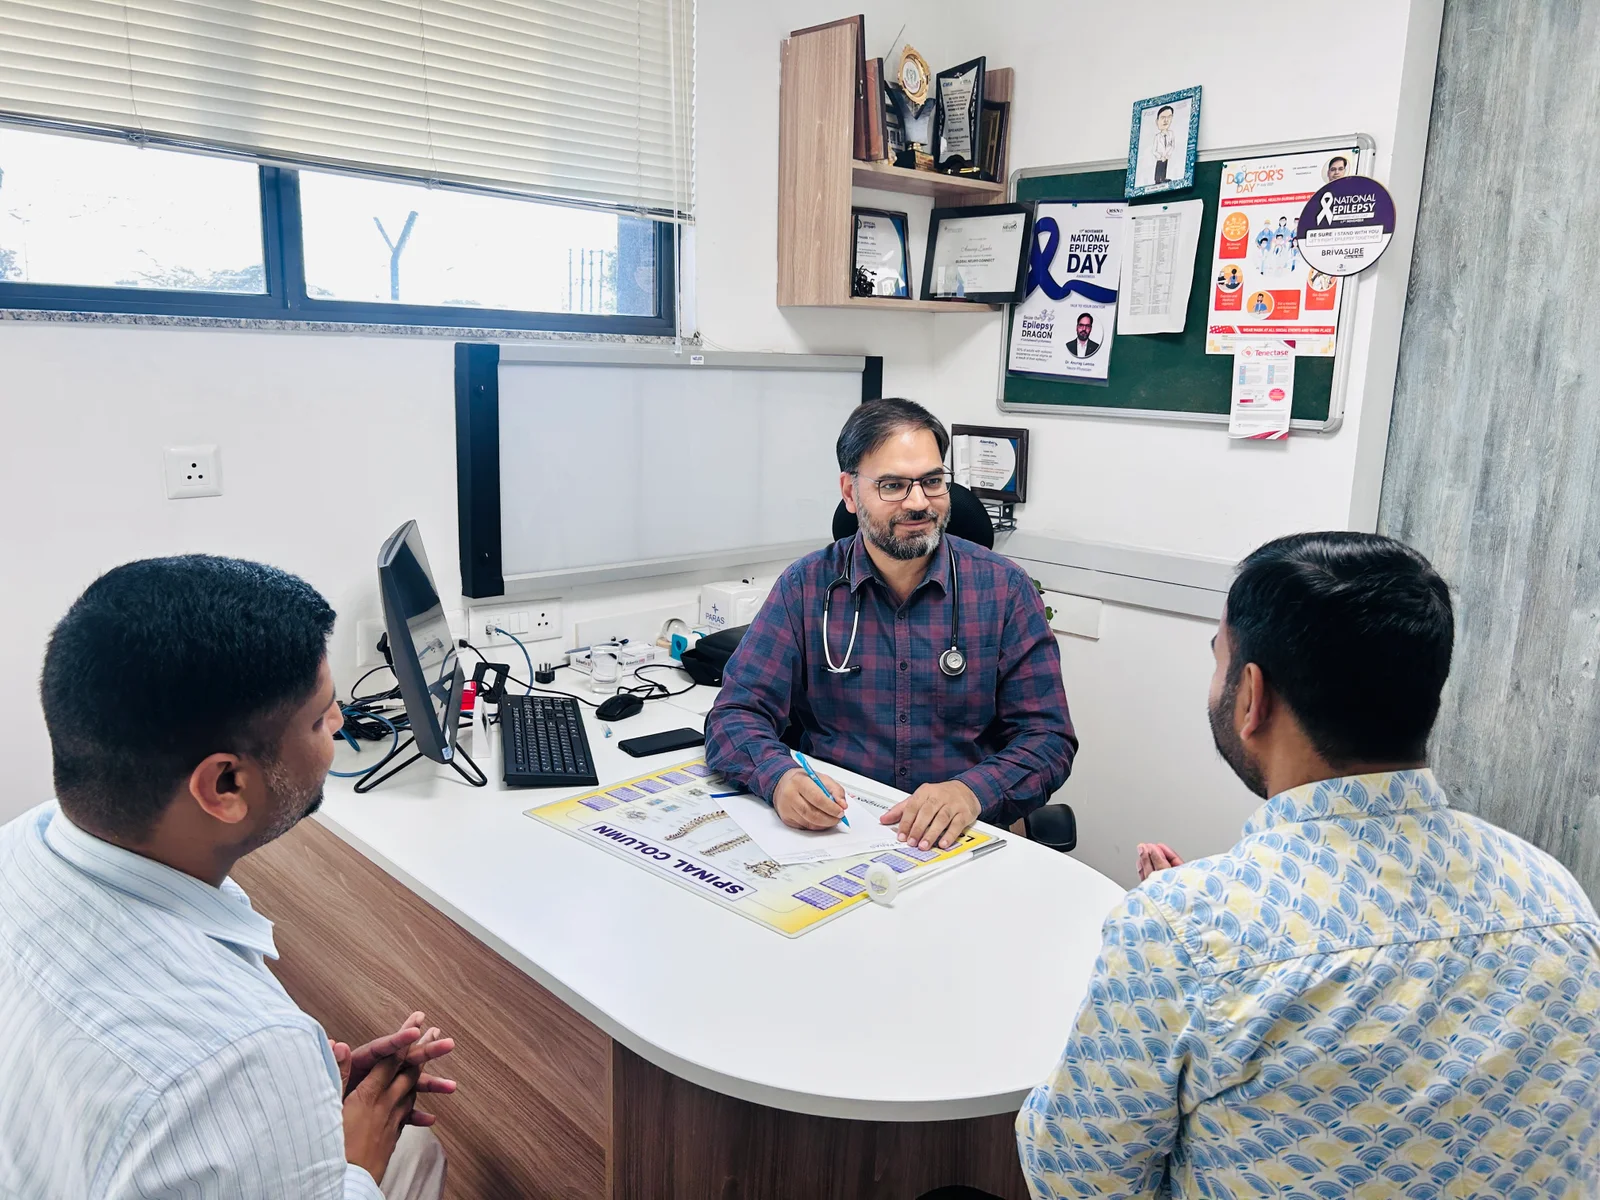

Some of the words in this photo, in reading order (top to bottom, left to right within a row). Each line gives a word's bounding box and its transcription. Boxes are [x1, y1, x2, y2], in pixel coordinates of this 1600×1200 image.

[1236, 183, 1256, 193] DAY
[1334, 194, 1376, 204] NATIONAL
[1333, 203, 1376, 215] EPILEPSY
[1070, 234, 1110, 242] NATIONAL
[1069, 244, 1109, 253] EPILEPSY
[1322, 248, 1364, 256] BRIVASURE
[1067, 254, 1108, 274] DAY
[1022, 320, 1054, 331] Epilepsy
[1021, 330, 1052, 339] DRAGON
[705, 613, 725, 624] PARAS
[592, 825, 671, 861] COLUMN
[673, 859, 744, 895] SPINAL
